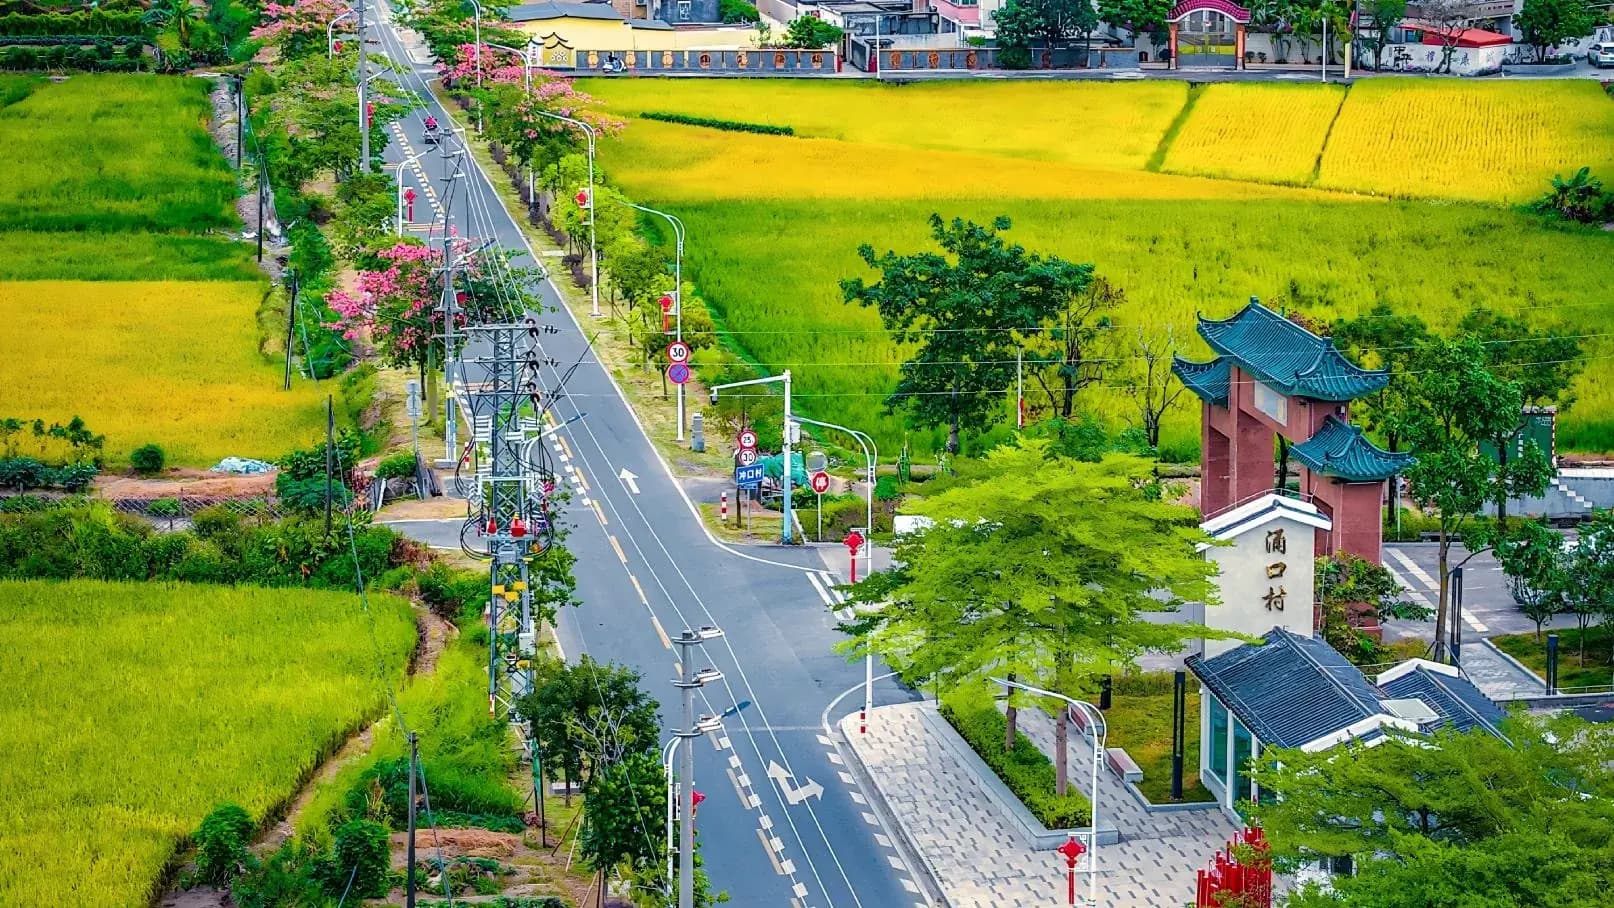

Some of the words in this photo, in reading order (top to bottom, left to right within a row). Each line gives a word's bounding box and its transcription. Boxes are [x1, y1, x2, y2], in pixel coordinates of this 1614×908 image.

[672, 347, 685, 358] 30
[743, 453, 753, 462] 30
[1261, 527, 1288, 612] 涌口村
